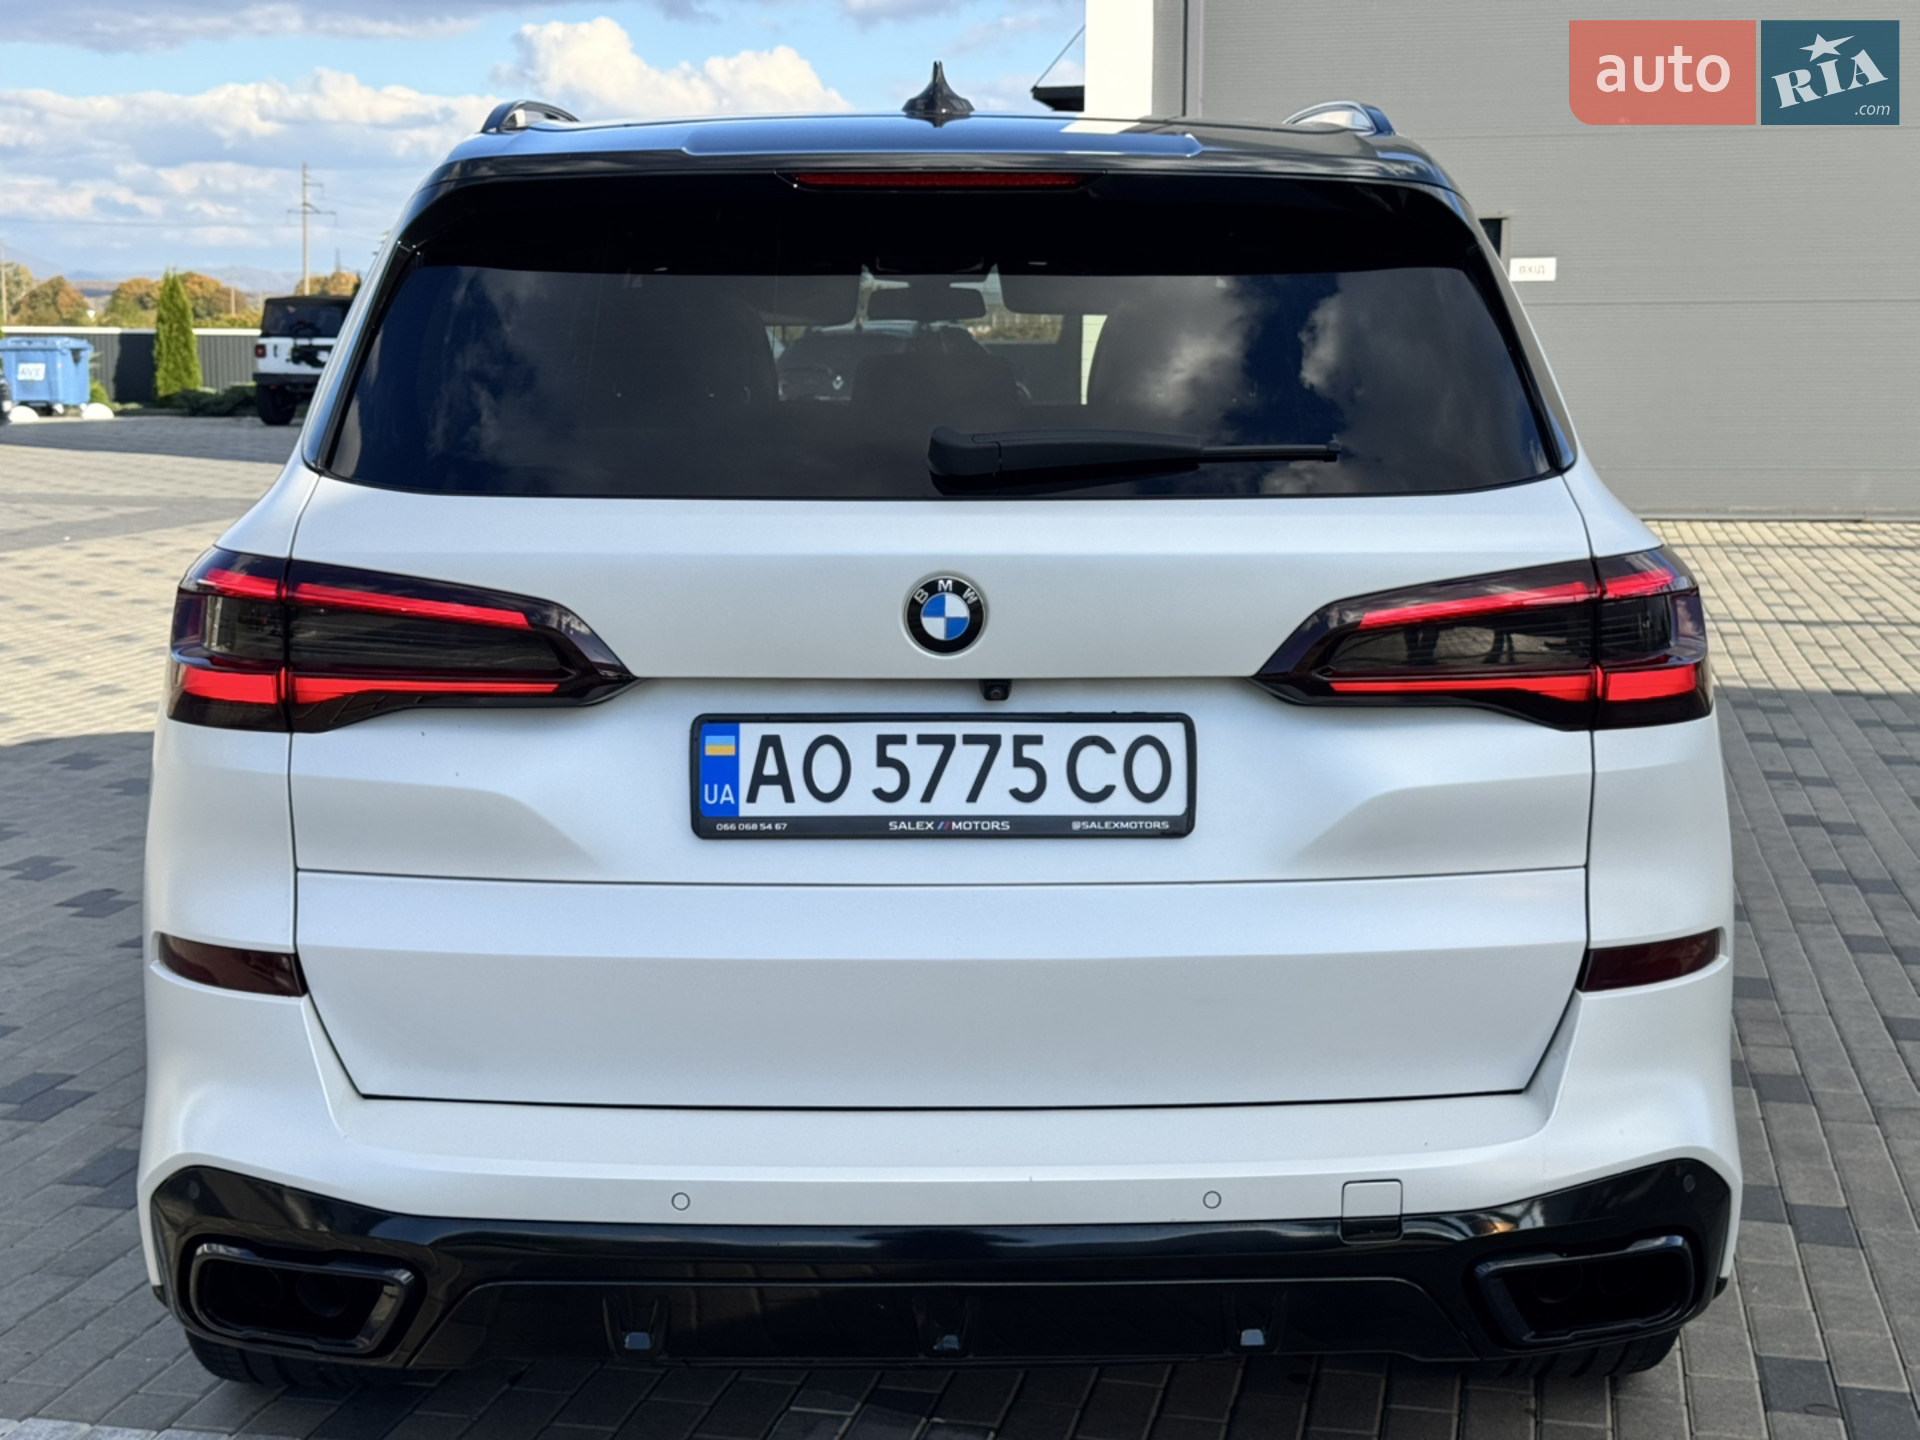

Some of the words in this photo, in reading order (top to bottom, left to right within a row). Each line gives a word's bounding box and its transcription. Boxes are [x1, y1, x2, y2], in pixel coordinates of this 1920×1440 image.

[913, 579, 978, 605] BMW
[745, 734, 852, 804] AO
[871, 734, 1048, 804] 5775
[1066, 734, 1172, 804] CO
[704, 784, 735, 805] UA
[716, 823, 737, 832] 066
[738, 823, 758, 832] 068
[759, 823, 773, 831] 54
[774, 823, 788, 831] 67
[889, 821, 935, 831] SALEX
[951, 821, 1011, 831] MOTORS
[1071, 820, 1170, 831] @SALEXMOTORS
